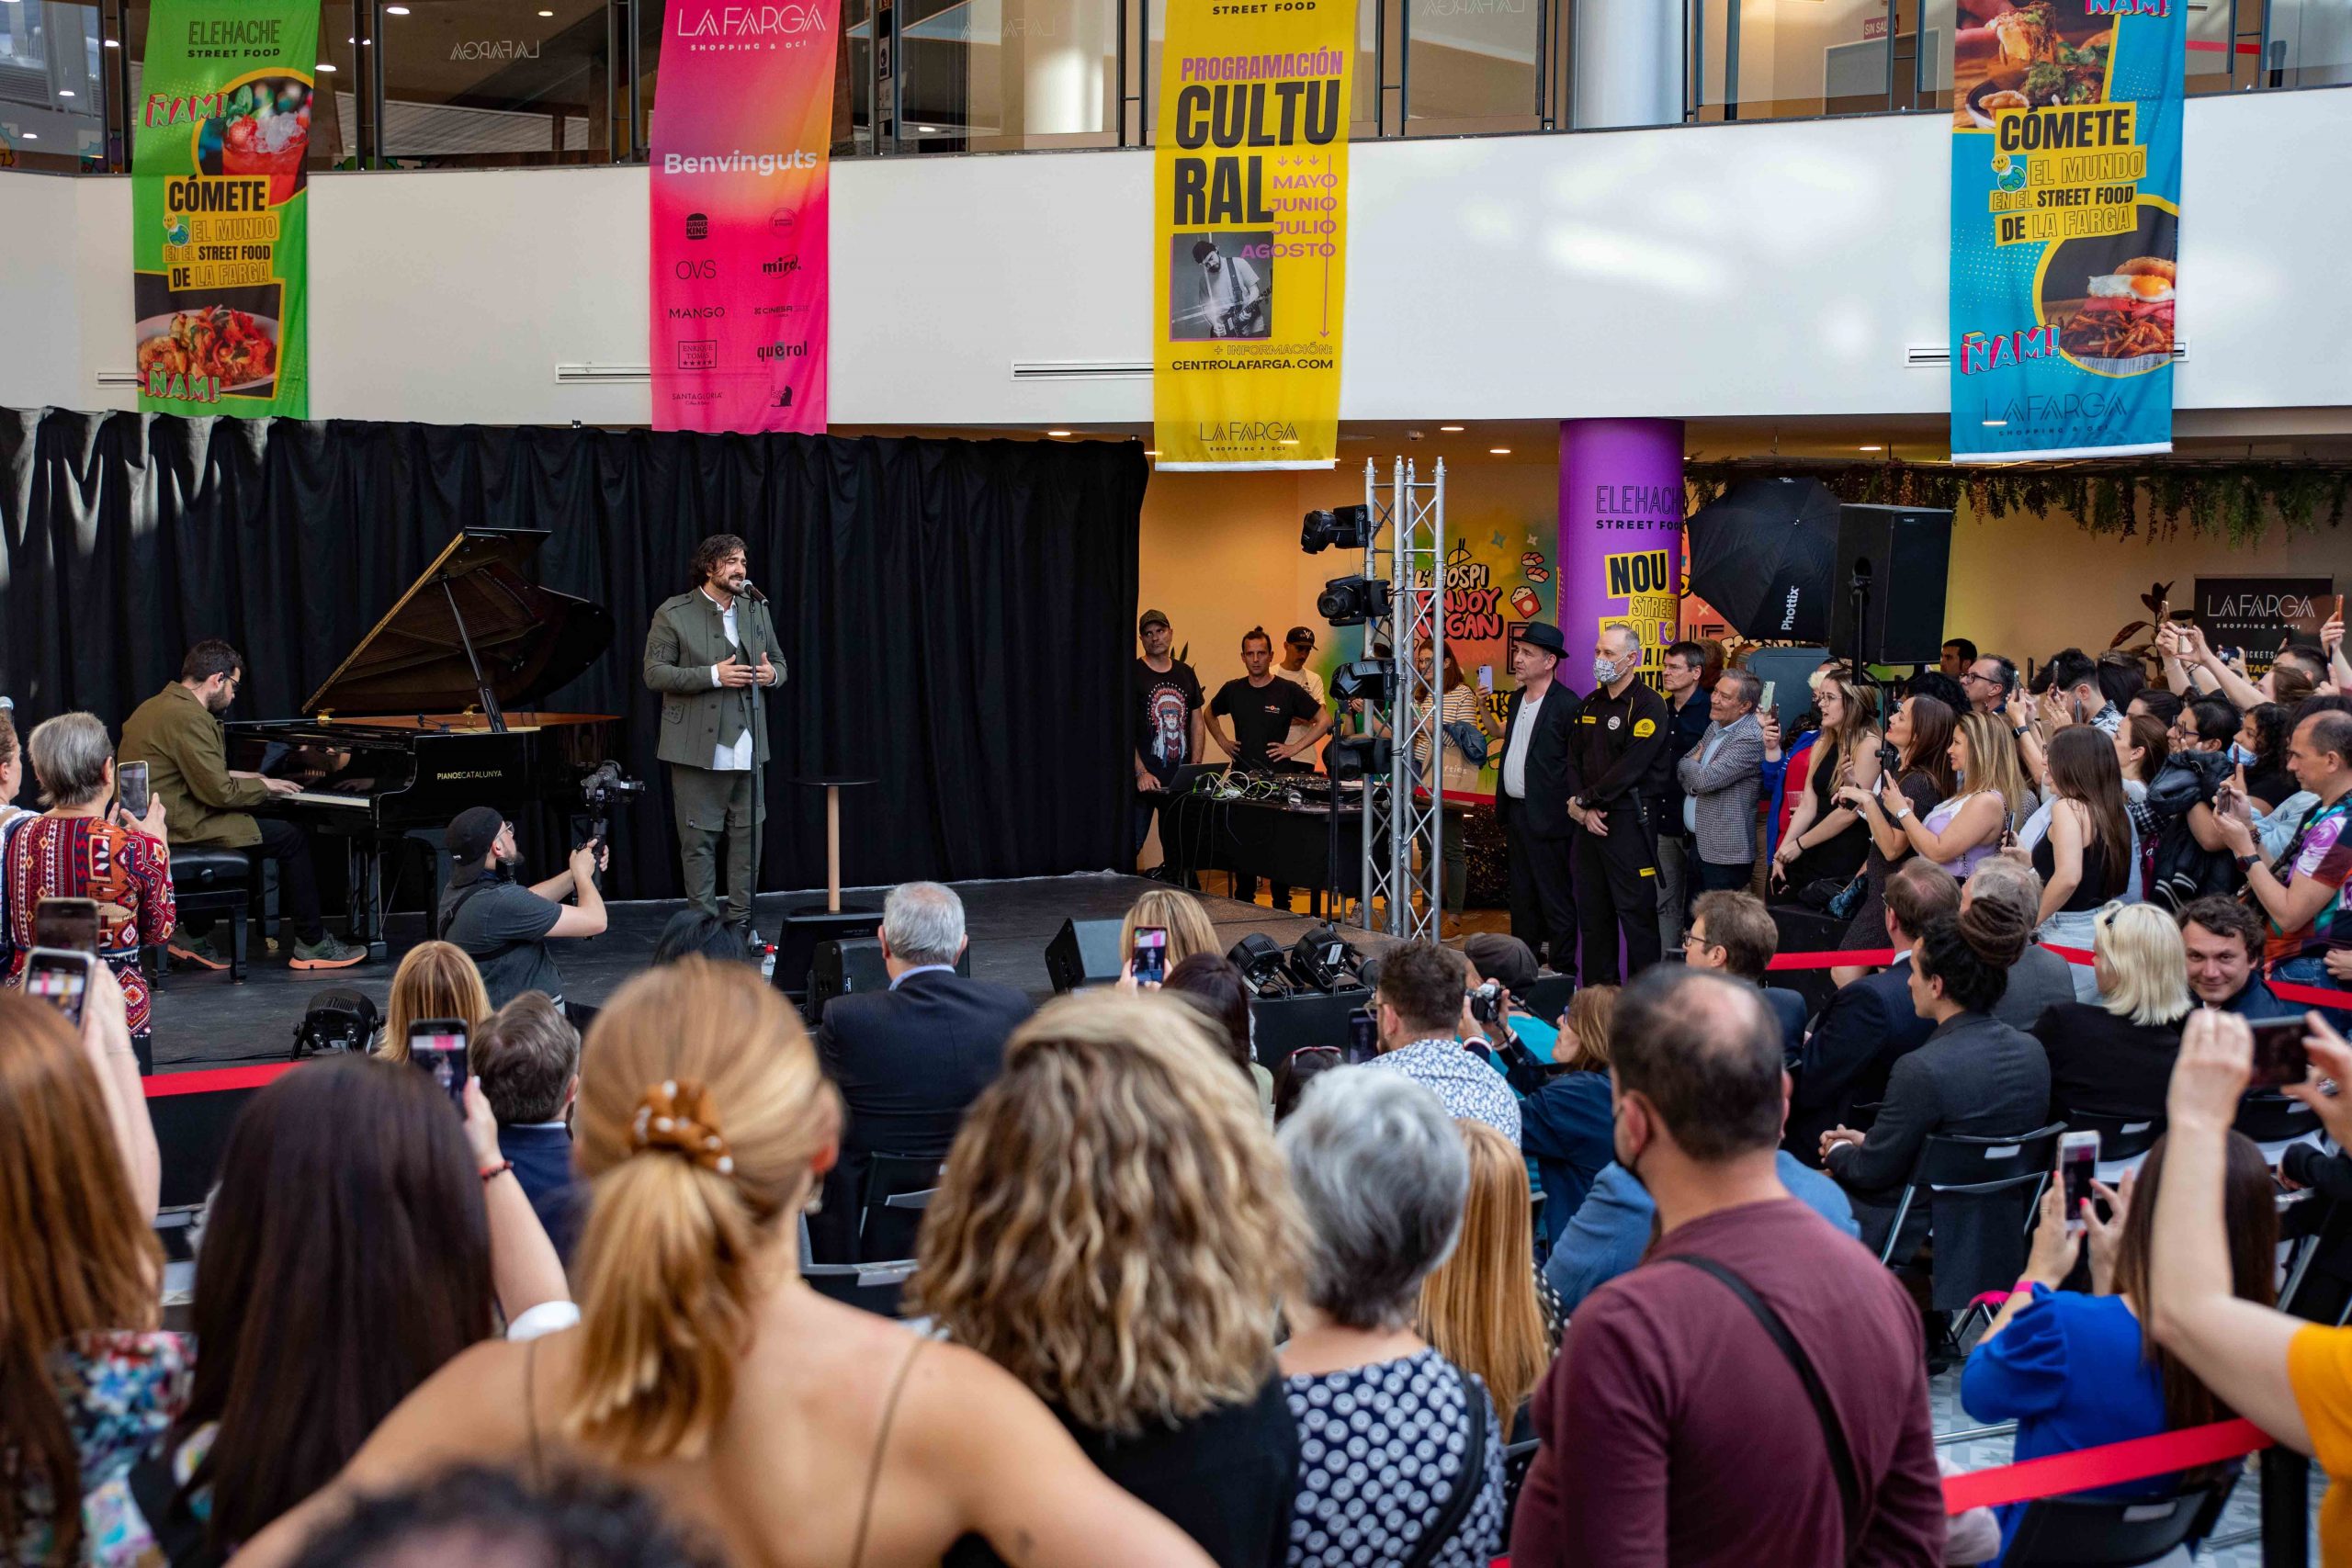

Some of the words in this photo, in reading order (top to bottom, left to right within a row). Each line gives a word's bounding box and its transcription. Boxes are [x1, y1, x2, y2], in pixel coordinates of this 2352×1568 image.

[1212, 4, 1268, 16] STREET
[1274, 2, 1317, 13] FOOD
[188, 19, 282, 45] ELEHACHE
[187, 49, 238, 59] STREET
[243, 48, 280, 58] FOOD
[690, 42, 761, 51] SHOPPING
[786, 39, 807, 49] OCI
[1181, 45, 1343, 82] PROGRAMACIÓN
[145, 92, 230, 129] ÑAM!
[1175, 79, 1340, 150] CULTU
[2000, 104, 2131, 152] CÓMETE
[663, 149, 818, 176] Benvinguts
[2030, 160, 2055, 186] EL
[2061, 151, 2143, 184] MUNDO
[168, 174, 266, 212] CÓMETE
[1173, 155, 1274, 226] RAL
[1272, 173, 1339, 189] MAYO
[1268, 196, 1338, 212] JUNIO
[1992, 192, 2011, 211] EN
[2015, 190, 2033, 209] EL
[2037, 188, 2091, 208] STREET
[2096, 186, 2134, 205] FOOD
[192, 220, 211, 243] EL
[216, 216, 277, 242] MUNDO
[685, 227, 708, 235] KING
[1272, 220, 1337, 235] JULIO
[2001, 216, 2026, 243] DE
[2032, 213, 2058, 239] LA
[2064, 206, 2131, 236] FARGA
[165, 246, 178, 261] EN
[181, 245, 196, 261] EL
[198, 245, 238, 261] STREET
[241, 245, 271, 260] FOOD
[1240, 243, 1336, 259] AGOSTO
[173, 267, 191, 288] DE
[195, 265, 215, 288] LA
[219, 262, 269, 285] FARGA
[675, 259, 717, 280] OVS
[669, 306, 726, 319] MANGO
[756, 340, 808, 362] querol
[1227, 341, 1333, 355] INFORMACIÓN:
[1961, 323, 2061, 375] ÑAM!
[1171, 359, 1333, 371] CENTROLAFARGA.COM
[144, 362, 220, 404] ÑAM!
[1998, 427, 2064, 437] SHOPPING
[1596, 519, 1654, 530] STREET
[1415, 564, 1488, 589] L'OSPI
[1609, 552, 1667, 595] NOU
[1631, 596, 1678, 620] STREET
[1781, 586, 1800, 630] Phottix
[1415, 613, 1500, 639] VGAN
[2245, 650, 2275, 660] ICKETS
